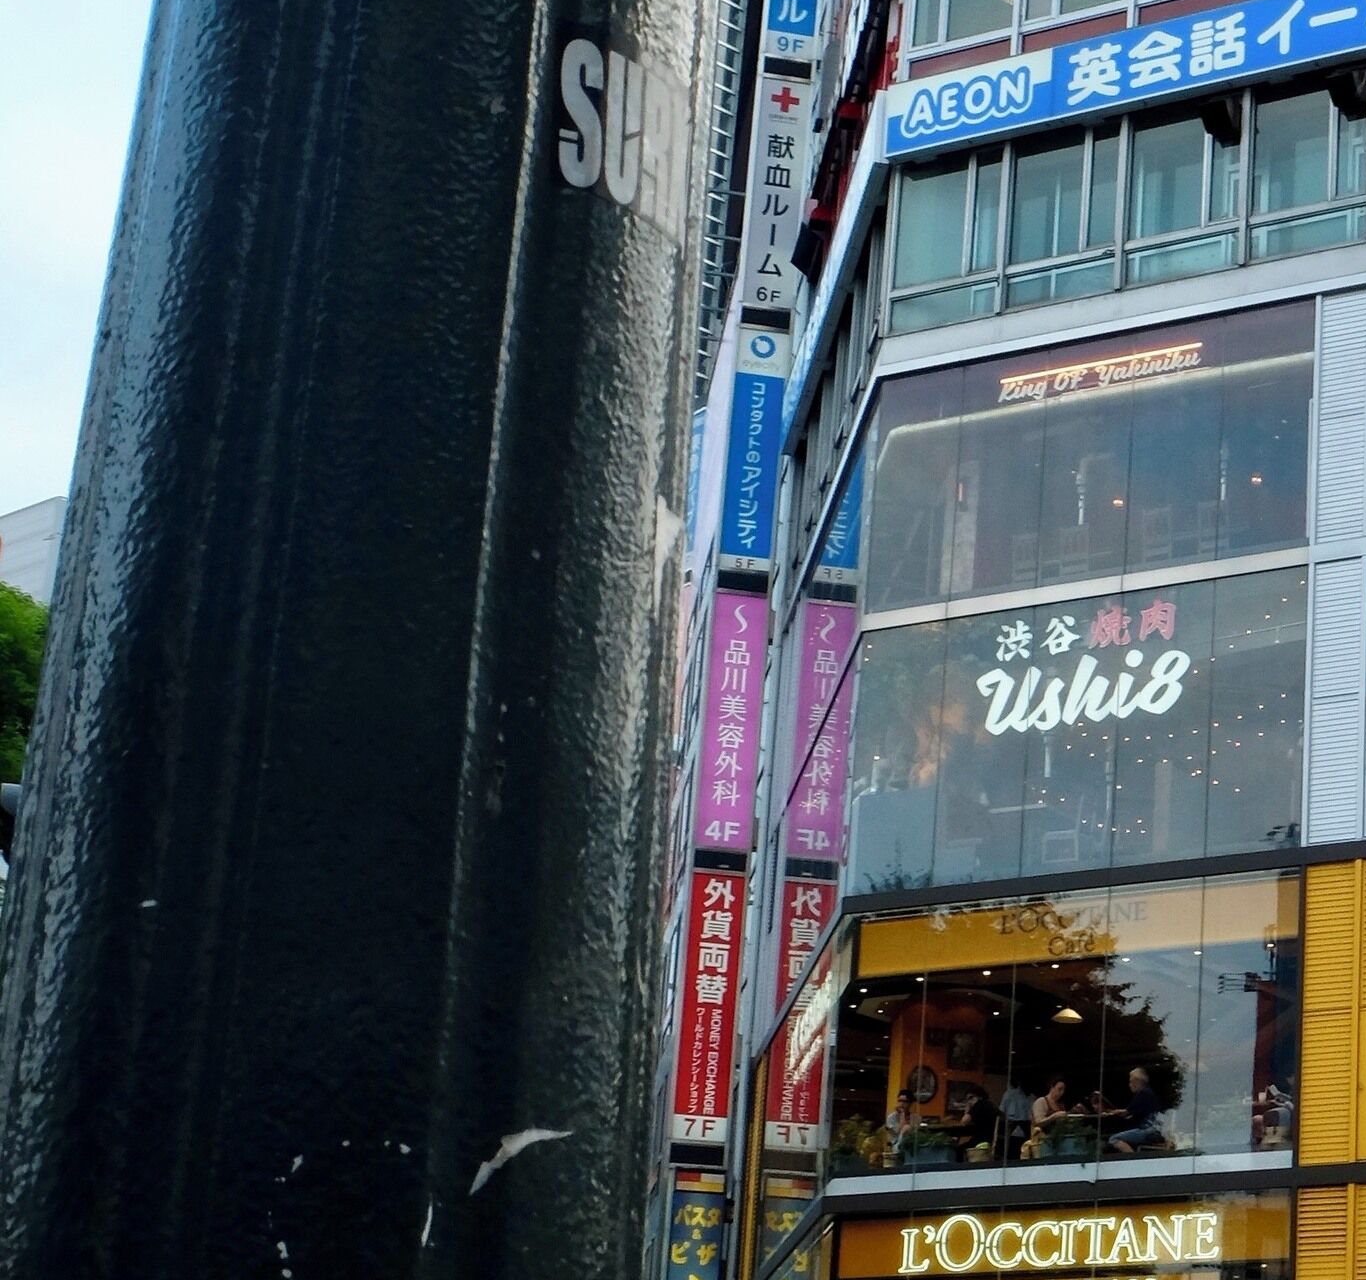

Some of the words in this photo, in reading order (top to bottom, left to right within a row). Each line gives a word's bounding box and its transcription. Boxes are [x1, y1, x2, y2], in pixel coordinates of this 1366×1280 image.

[777, 36, 806, 54] 9F
[904, 70, 1031, 132] AEON
[757, 133, 796, 278] 献血ルーム
[756, 285, 782, 304] 6F
[997, 379, 1048, 404] King
[1097, 349, 1203, 387] Yakiniku
[737, 381, 766, 551] コンタクトのアイシティ
[735, 557, 756, 570] 5F
[975, 648, 1191, 737] Ushi8
[713, 639, 750, 810] 品川美容外科
[705, 820, 740, 843] 4F
[696, 877, 736, 1006] 外貨両替
[707, 1008, 723, 1051] MONEY
[702, 1050, 720, 1116] EXCHANGE
[684, 1117, 717, 1137] 7F
[675, 1205, 721, 1226] パスタ
[897, 1211, 1221, 1275] L'OCCITANE
[671, 1243, 717, 1266] ピザ
